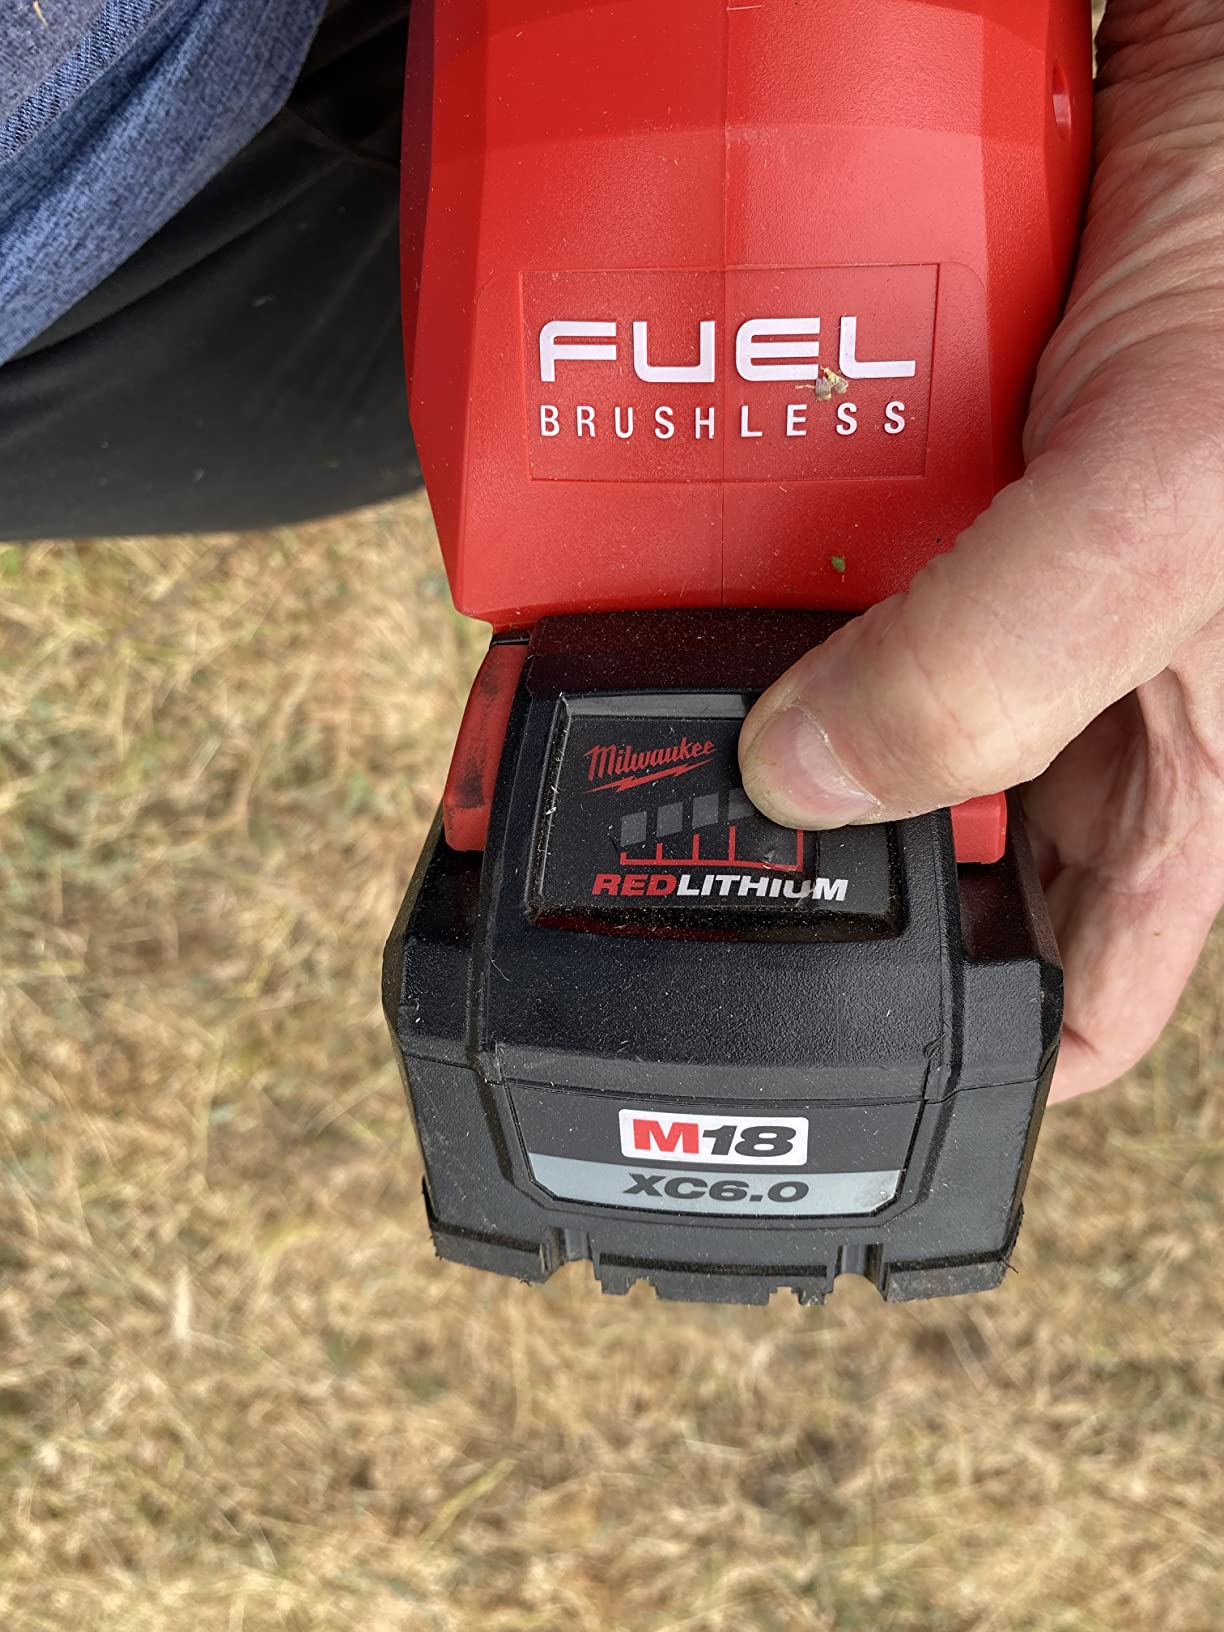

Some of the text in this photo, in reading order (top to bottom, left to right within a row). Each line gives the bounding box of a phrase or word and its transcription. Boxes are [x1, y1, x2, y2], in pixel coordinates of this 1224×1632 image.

[539, 316, 916, 383] FUEL
[540, 401, 906, 439] BRUSHLESS
[583, 736, 717, 782] Milwaukee
[592, 873, 849, 901] REDLITHIUM
[632, 1118, 798, 1157] M18
[622, 1173, 810, 1203] XC6.0
